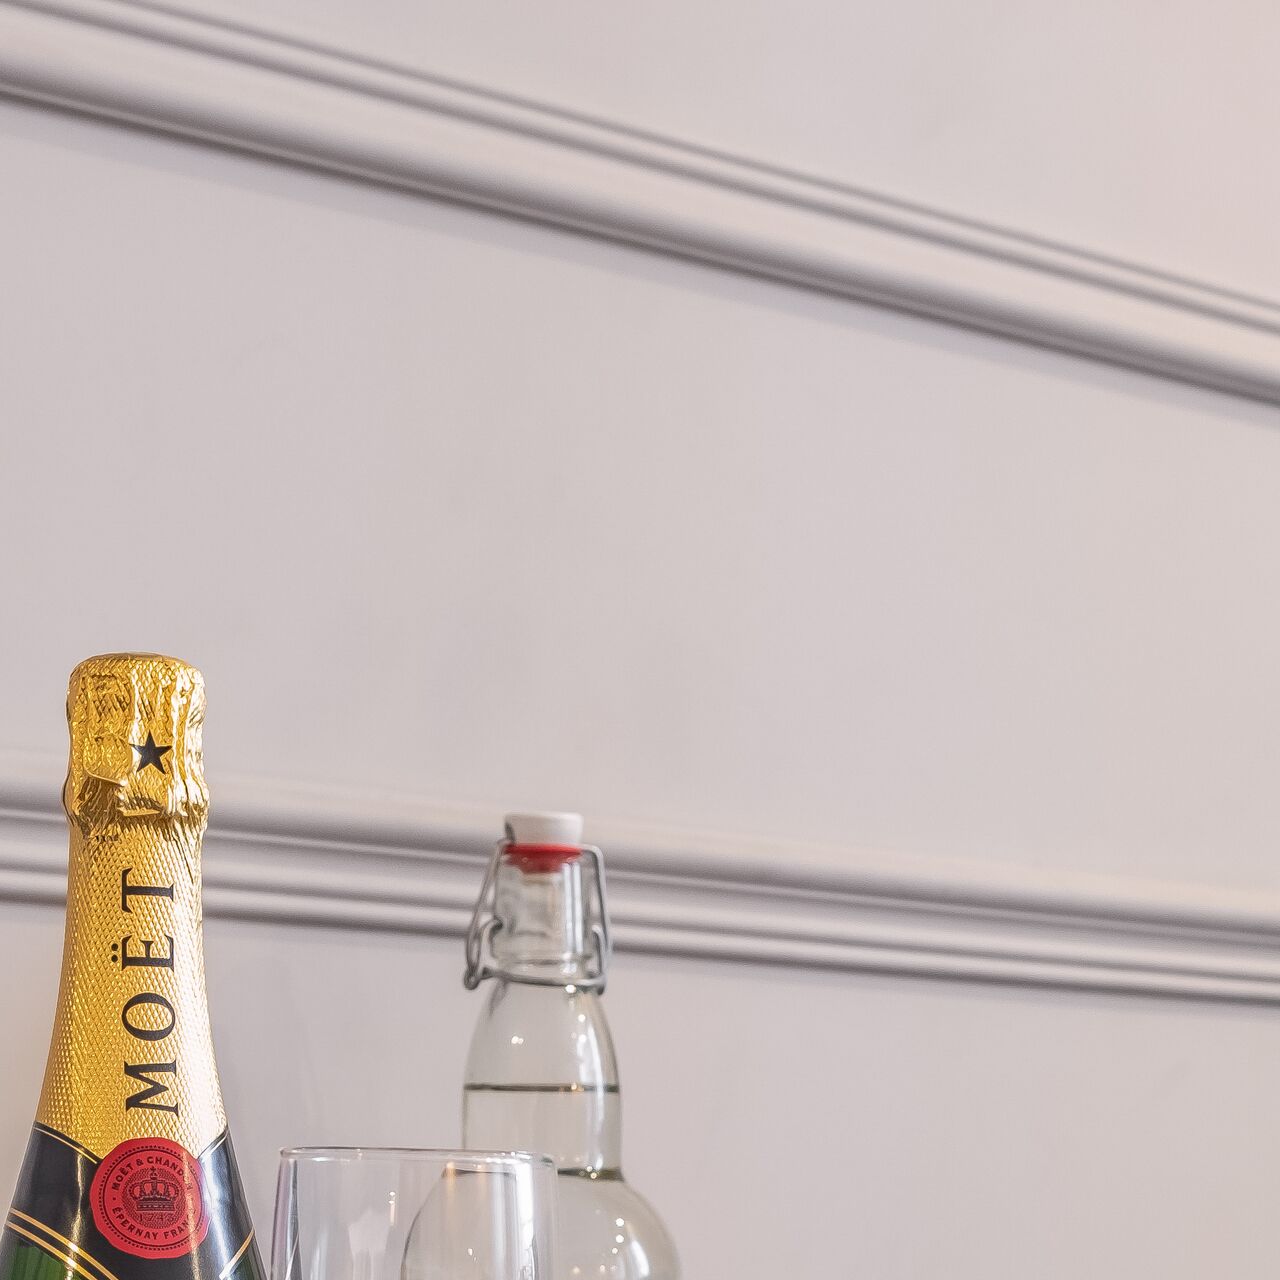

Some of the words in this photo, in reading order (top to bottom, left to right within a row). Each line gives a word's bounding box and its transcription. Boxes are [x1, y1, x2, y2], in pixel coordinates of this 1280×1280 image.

[111, 866, 180, 1117] MOËT
[111, 1163, 134, 1191] MOËT
[136, 1158, 144, 1166] &
[147, 1155, 194, 1191] CHANDN
[163, 1207, 197, 1240] FRAN
